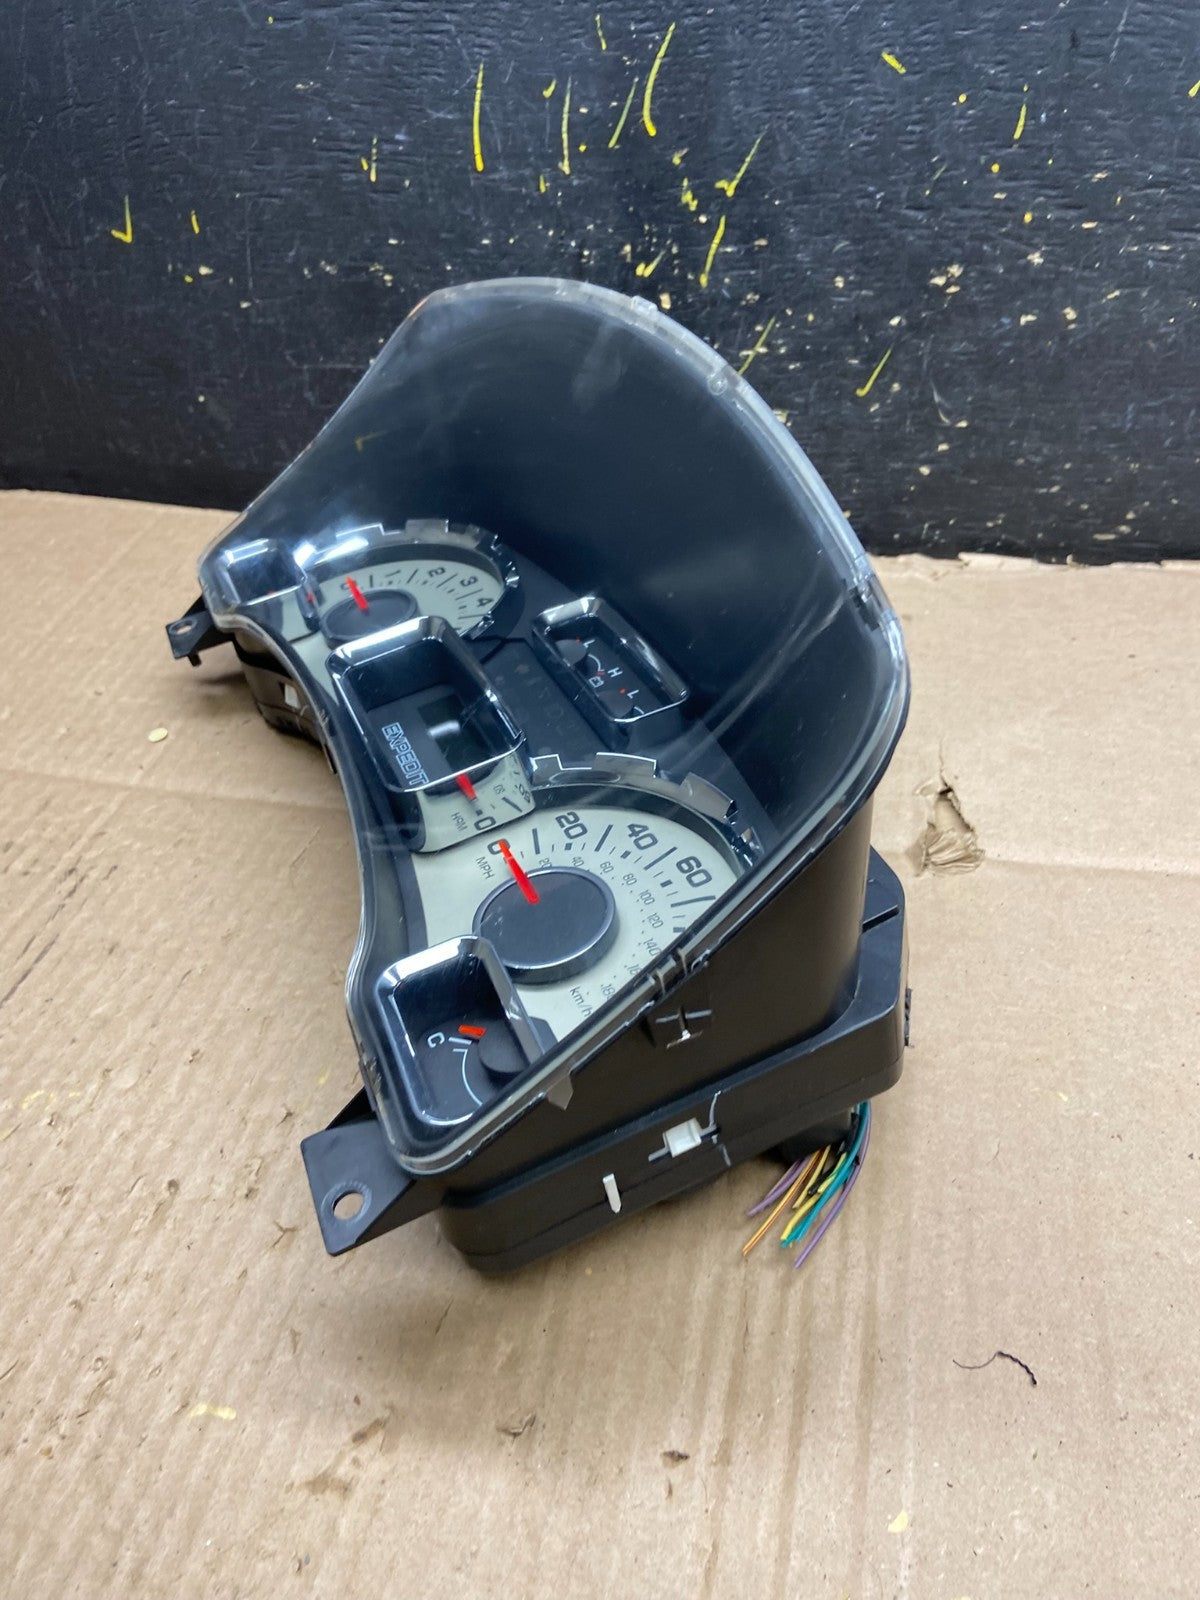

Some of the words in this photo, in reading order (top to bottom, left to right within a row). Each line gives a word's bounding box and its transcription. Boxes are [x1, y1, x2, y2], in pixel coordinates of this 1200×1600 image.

[428, 567, 446, 578] 2
[460, 575, 478, 588] 3
[478, 597, 493, 607] 4
[583, 639, 596, 648] L
[608, 668, 623, 677] H
[627, 689, 640, 699] L
[381, 722, 429, 785] EXPEDIT
[555, 811, 588, 840] 20
[627, 823, 659, 852] 40
[487, 838, 511, 855] 0
[475, 856, 495, 880] MPH
[572, 856, 585, 870] 40
[599, 861, 614, 873] 60
[622, 873, 638, 886] 80
[675, 855, 713, 889] 60
[640, 890, 655, 905] 100
[647, 912, 664, 928] 120
[643, 938, 663, 957] 140
[569, 987, 592, 1017] km/h
[428, 1032, 445, 1048] C
